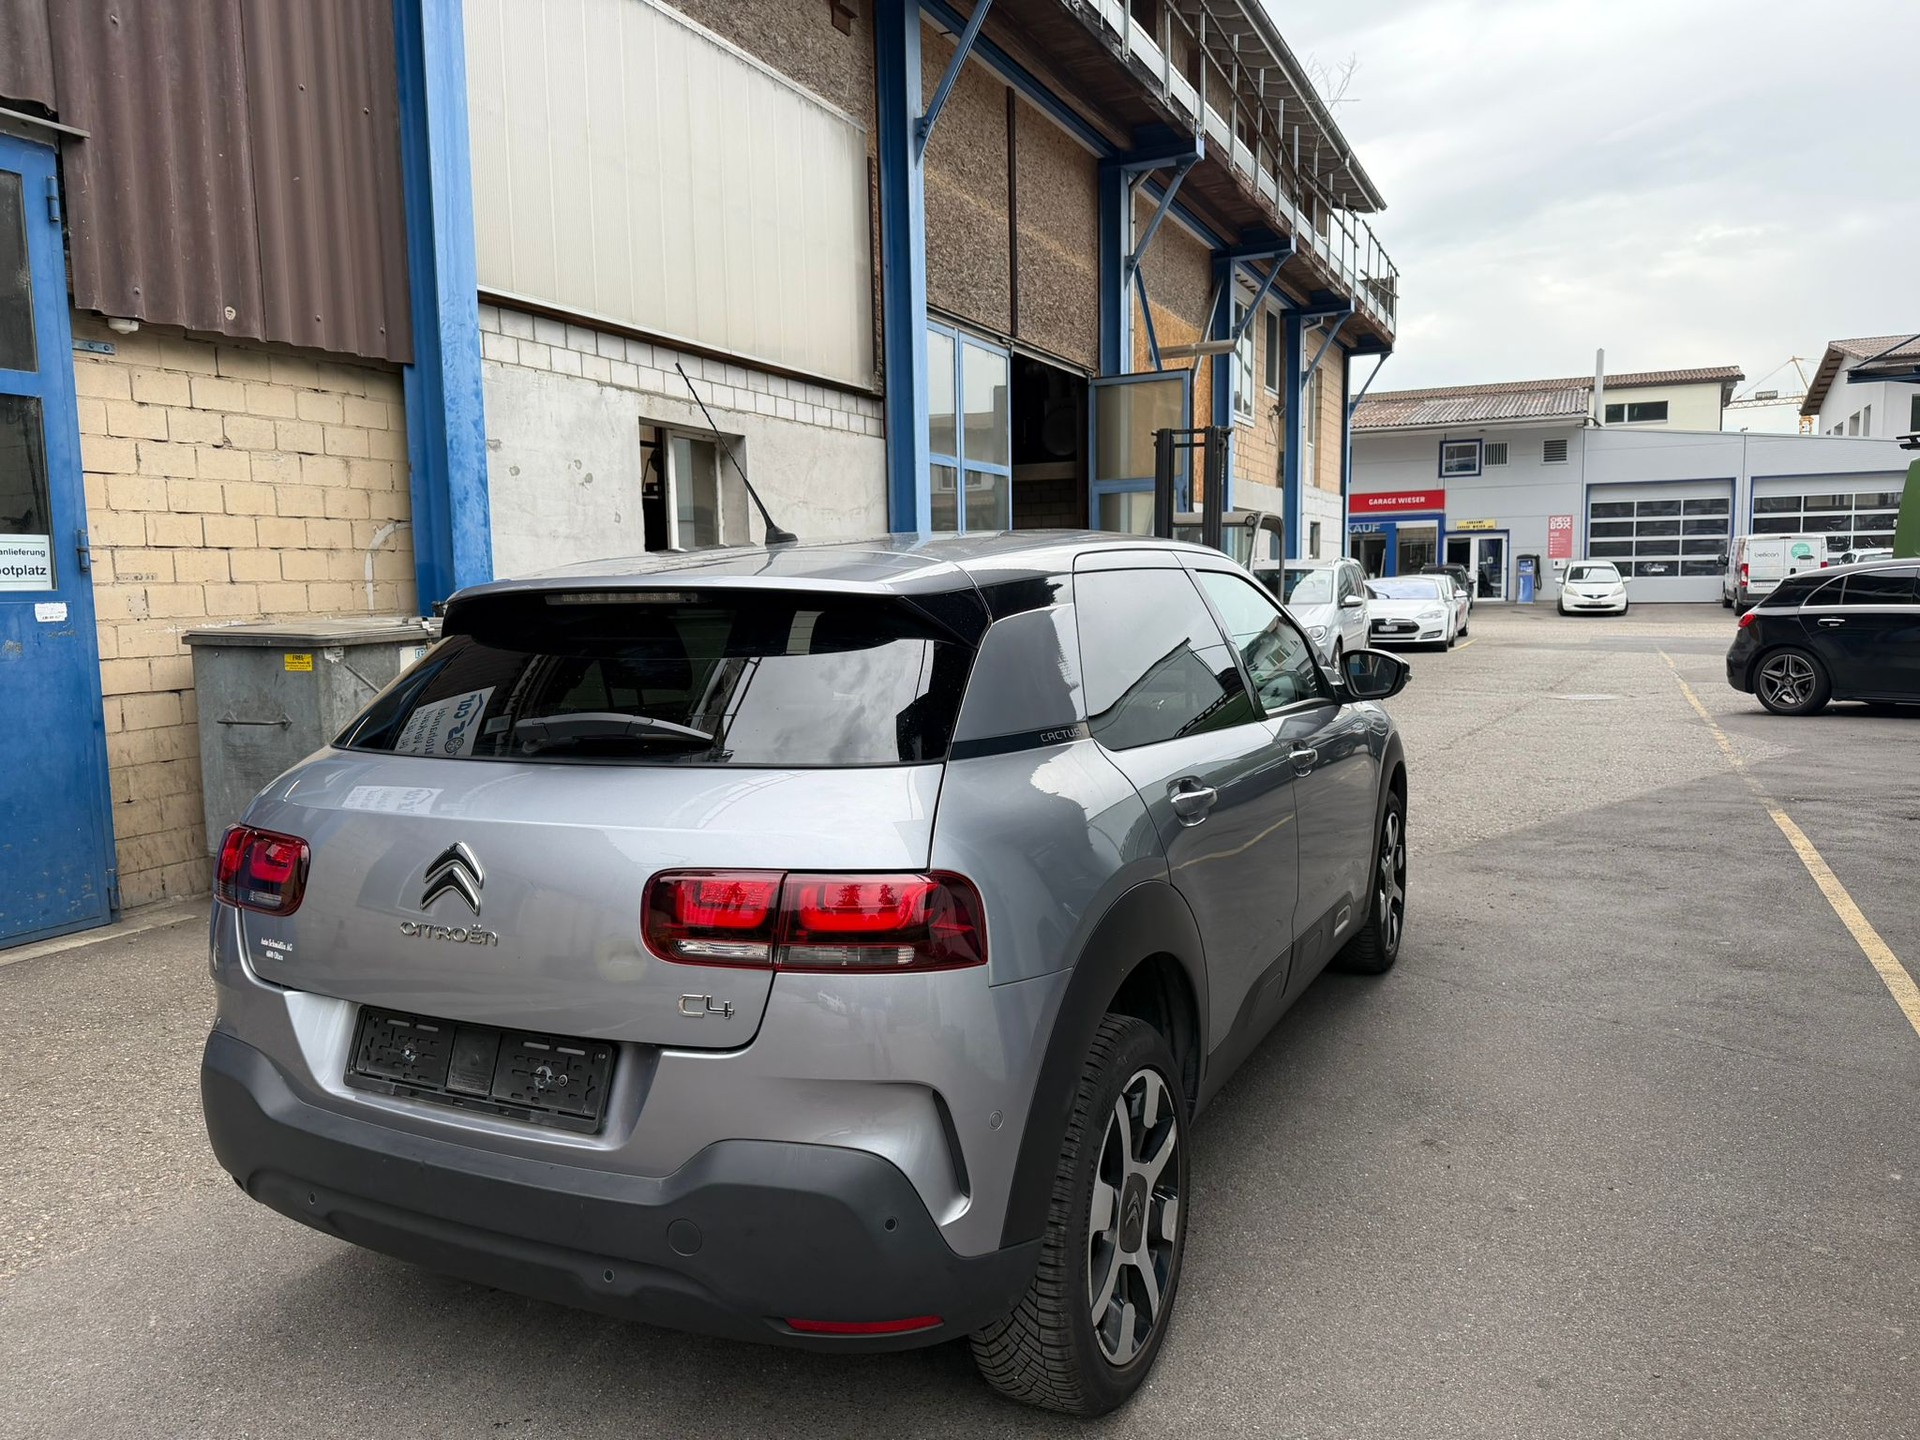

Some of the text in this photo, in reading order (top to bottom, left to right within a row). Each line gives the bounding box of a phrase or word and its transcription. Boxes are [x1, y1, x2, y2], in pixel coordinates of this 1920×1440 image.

[1368, 496, 1425, 506] GARAGE WIESER
[1550, 522, 1571, 530] BOX
[0, 565, 47, 578] otplatz
[1040, 728, 1082, 742] CACTUS
[400, 921, 498, 947] CITROËN
[679, 993, 735, 1019] C4
